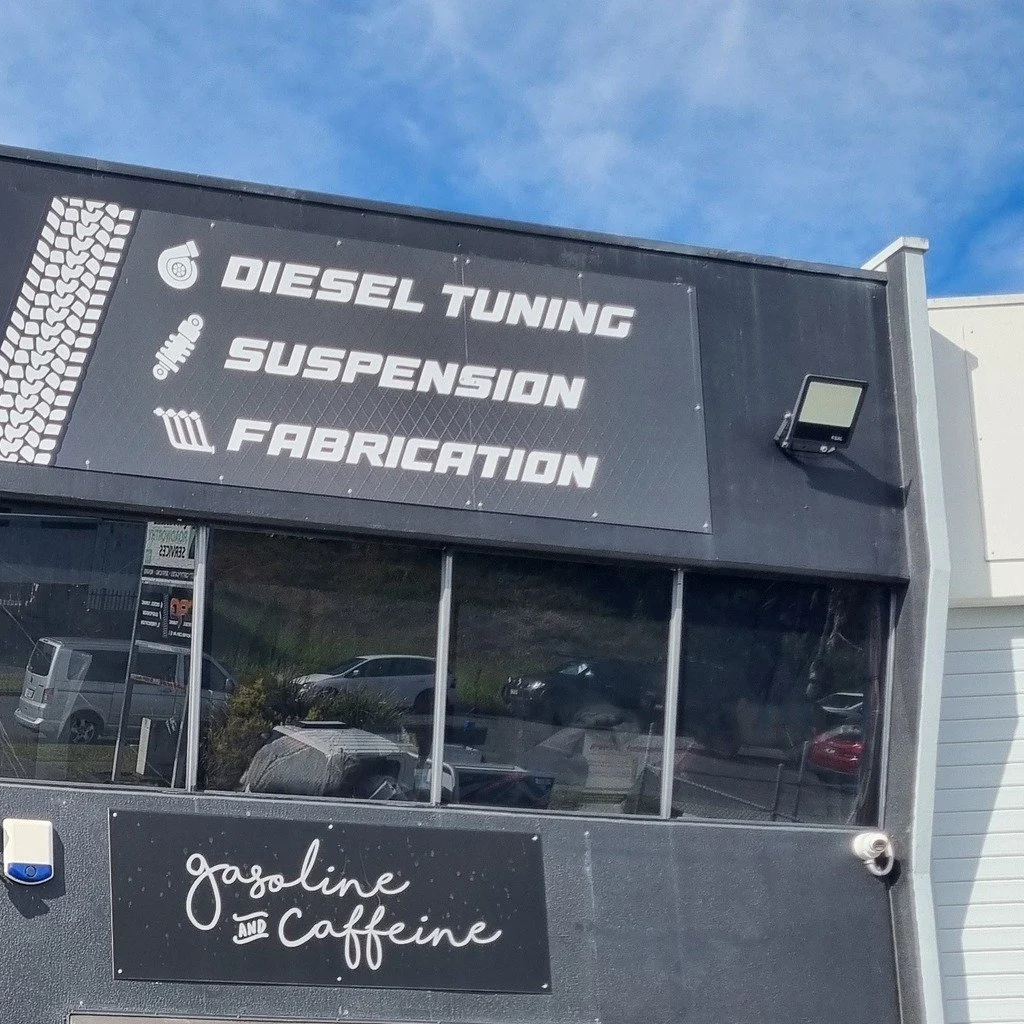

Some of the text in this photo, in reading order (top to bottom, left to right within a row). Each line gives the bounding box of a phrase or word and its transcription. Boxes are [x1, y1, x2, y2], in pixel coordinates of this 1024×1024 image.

[220, 255, 636, 339] DIESEL TUNING
[224, 337, 586, 410] SUSPENSION
[226, 418, 599, 489] FABRICATION
[186, 838, 411, 931] gasoline
[237, 918, 268, 938] AND
